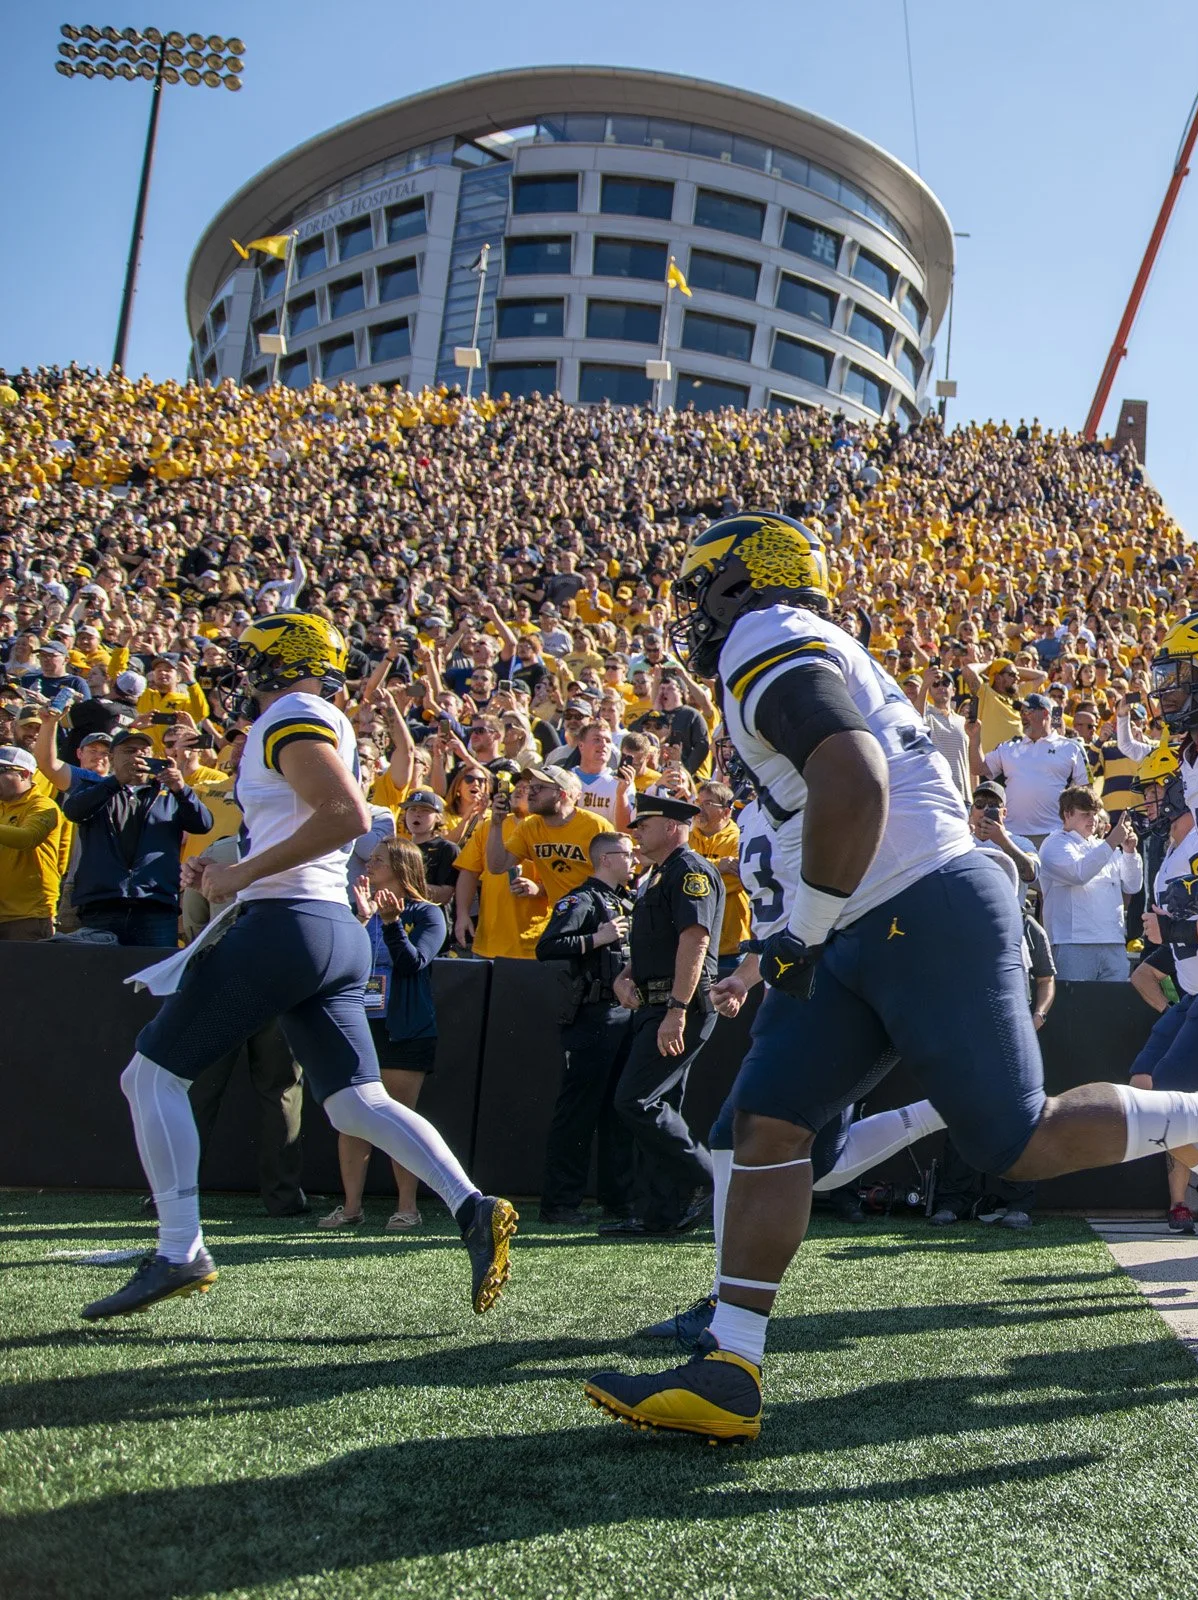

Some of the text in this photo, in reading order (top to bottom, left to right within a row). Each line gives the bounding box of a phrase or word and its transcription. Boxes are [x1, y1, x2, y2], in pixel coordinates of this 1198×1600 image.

[351, 178, 418, 217] HOSPITAL
[584, 792, 611, 808] Blue
[534, 843, 587, 863] IOWA
[739, 834, 785, 923] 3
